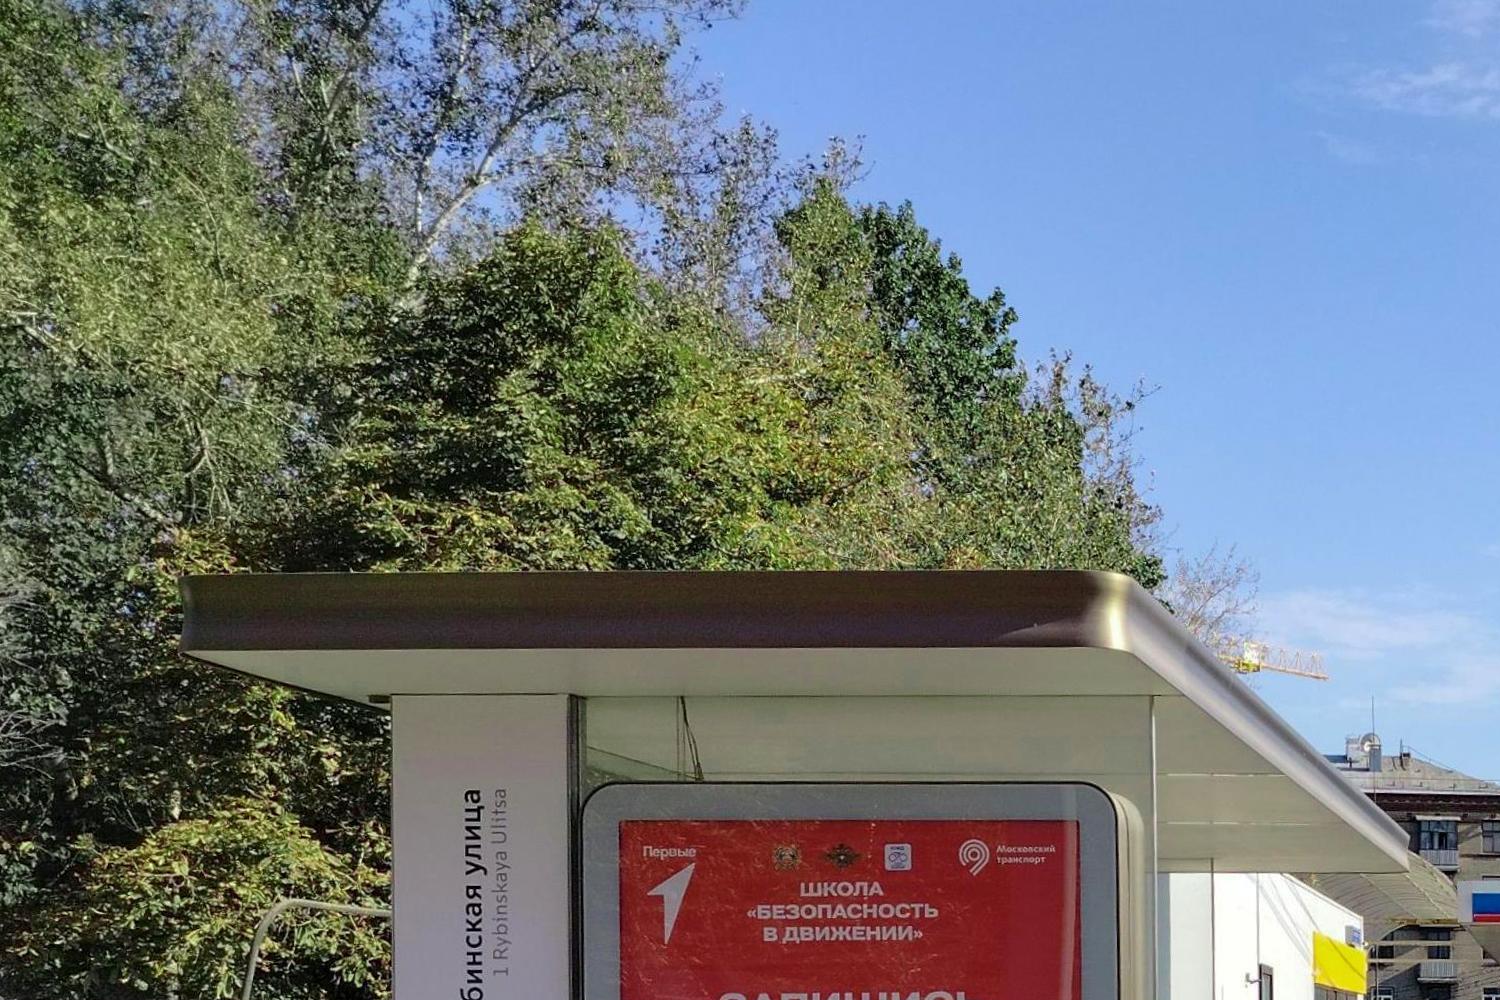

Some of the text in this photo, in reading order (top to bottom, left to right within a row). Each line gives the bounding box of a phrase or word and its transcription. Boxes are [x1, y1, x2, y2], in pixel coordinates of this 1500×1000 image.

[463, 789, 487, 875] улица
[642, 844, 697, 858] Первые
[996, 843, 1056, 854] Московский
[996, 855, 1046, 865] транспорт
[493, 788, 512, 976] 1 Rybinskaya Ulitsa
[800, 881, 884, 897] ШКОЛА
[747, 903, 939, 920] «БЕЗОПАСНОСТЬ
[763, 926, 923, 944] В ДВИЖЕНИИ»
